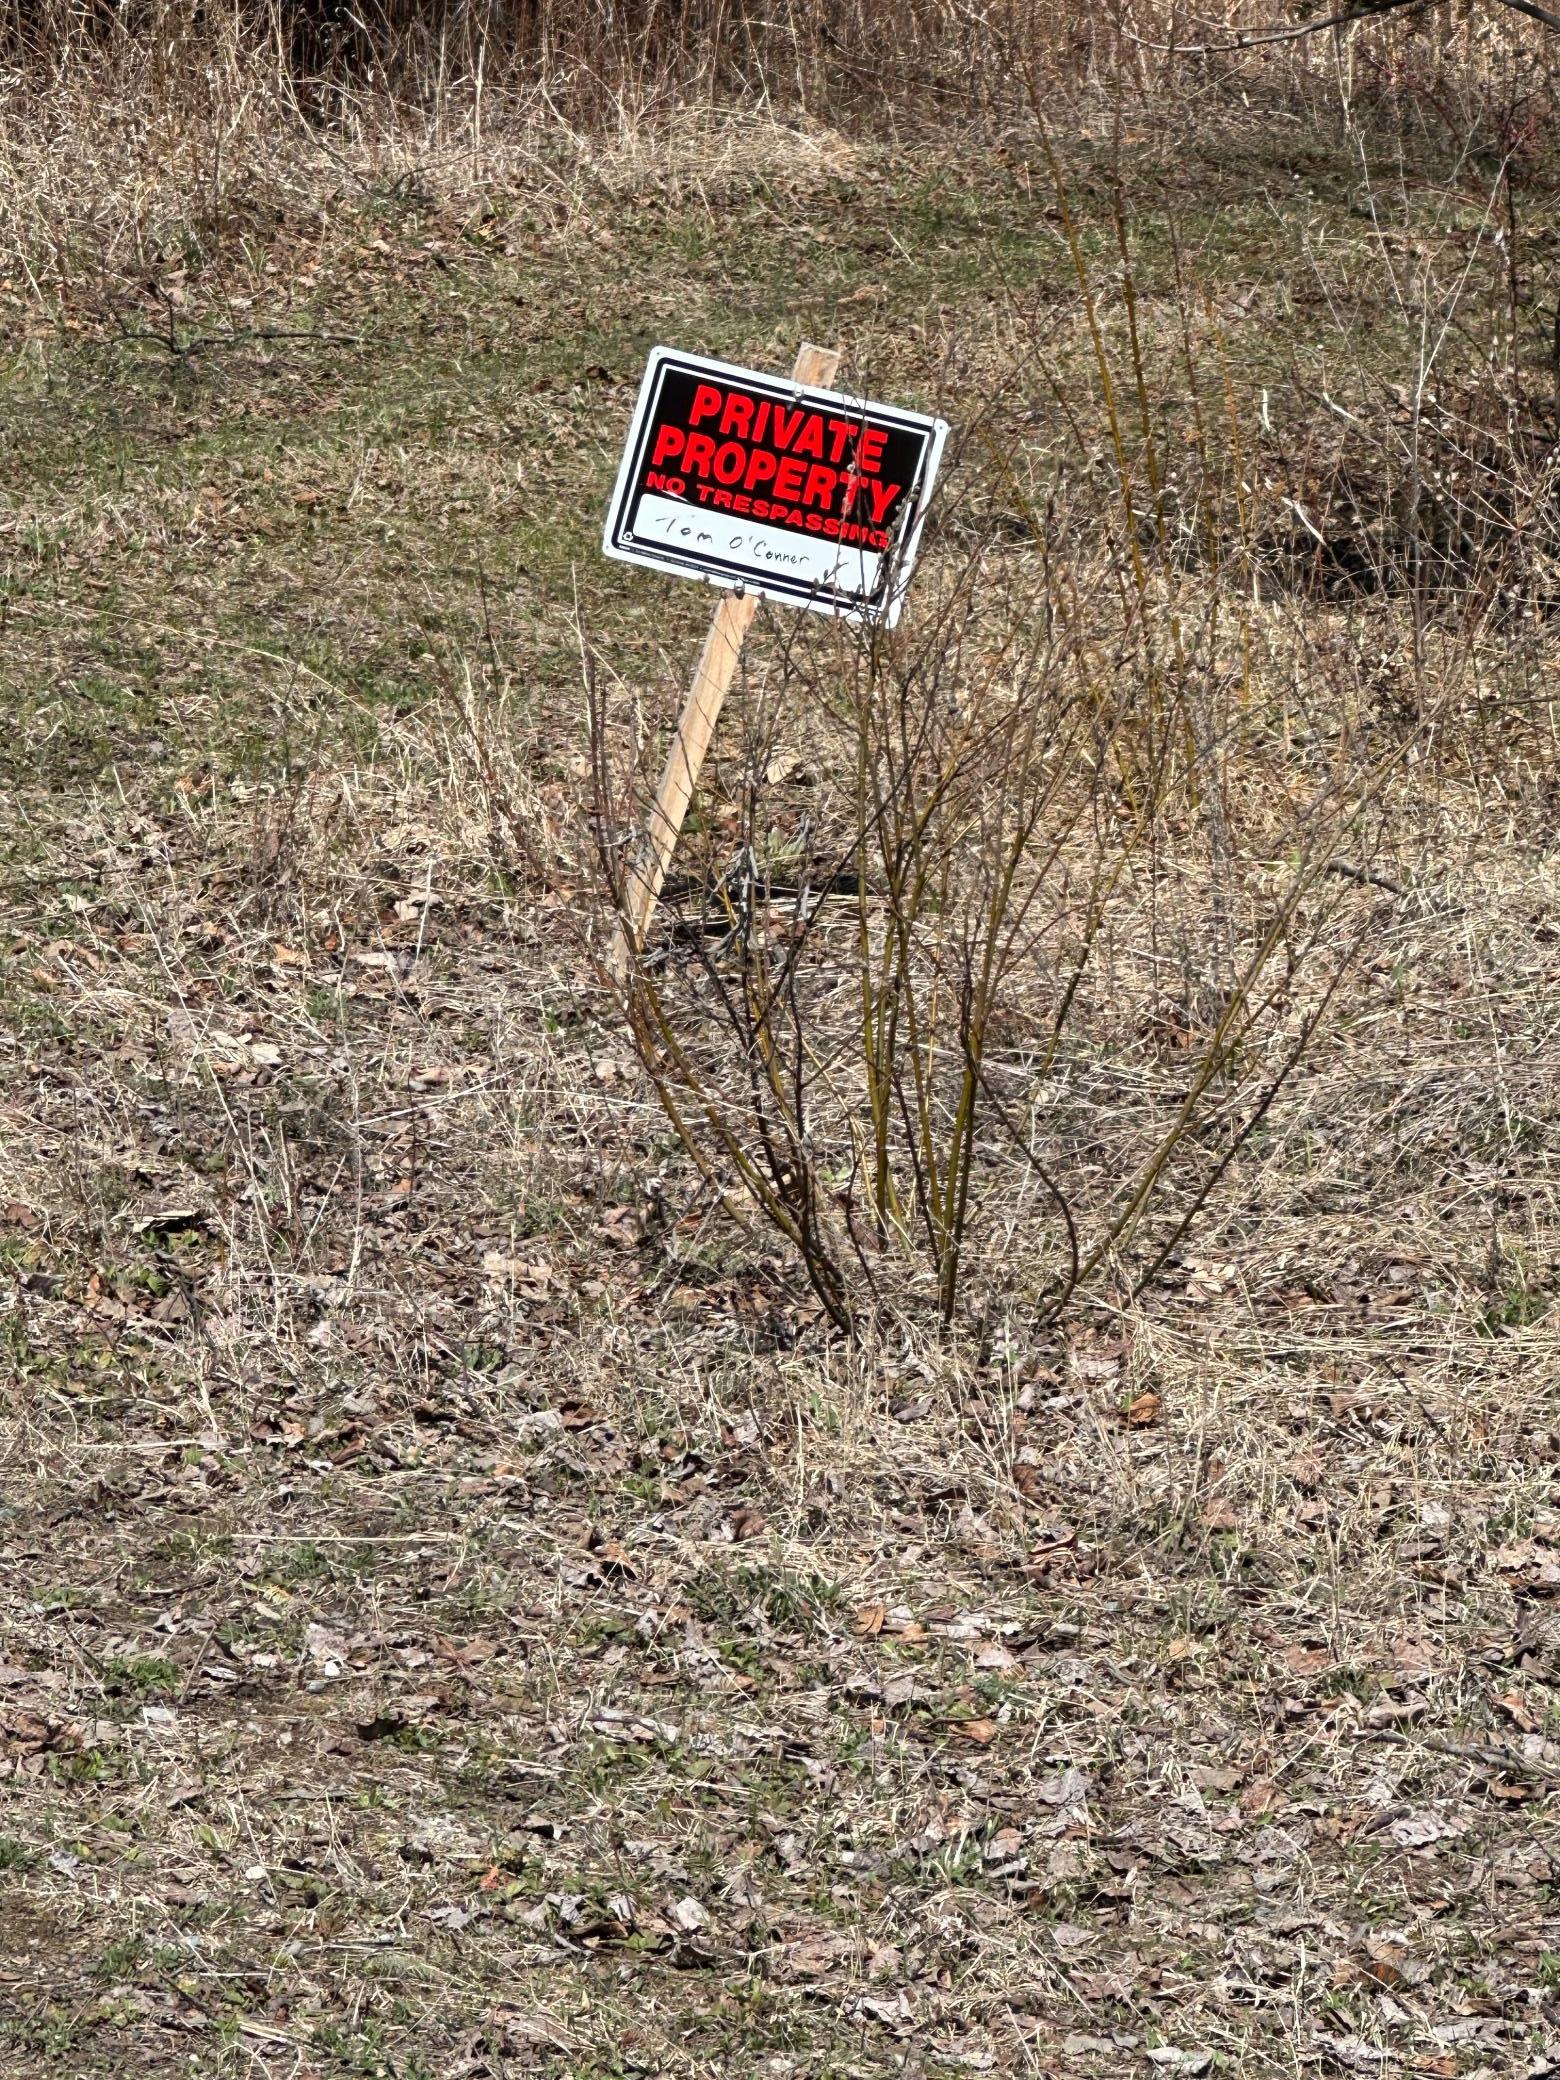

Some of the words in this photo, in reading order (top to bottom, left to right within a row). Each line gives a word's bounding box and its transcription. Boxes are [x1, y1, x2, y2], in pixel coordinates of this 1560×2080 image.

[689, 384, 889, 473] PRIVATE
[645, 471, 686, 496] NO
[696, 483, 890, 548] TRESPASSING
[651, 424, 901, 523] PROPERTY
[655, 517, 713, 544] Tom
